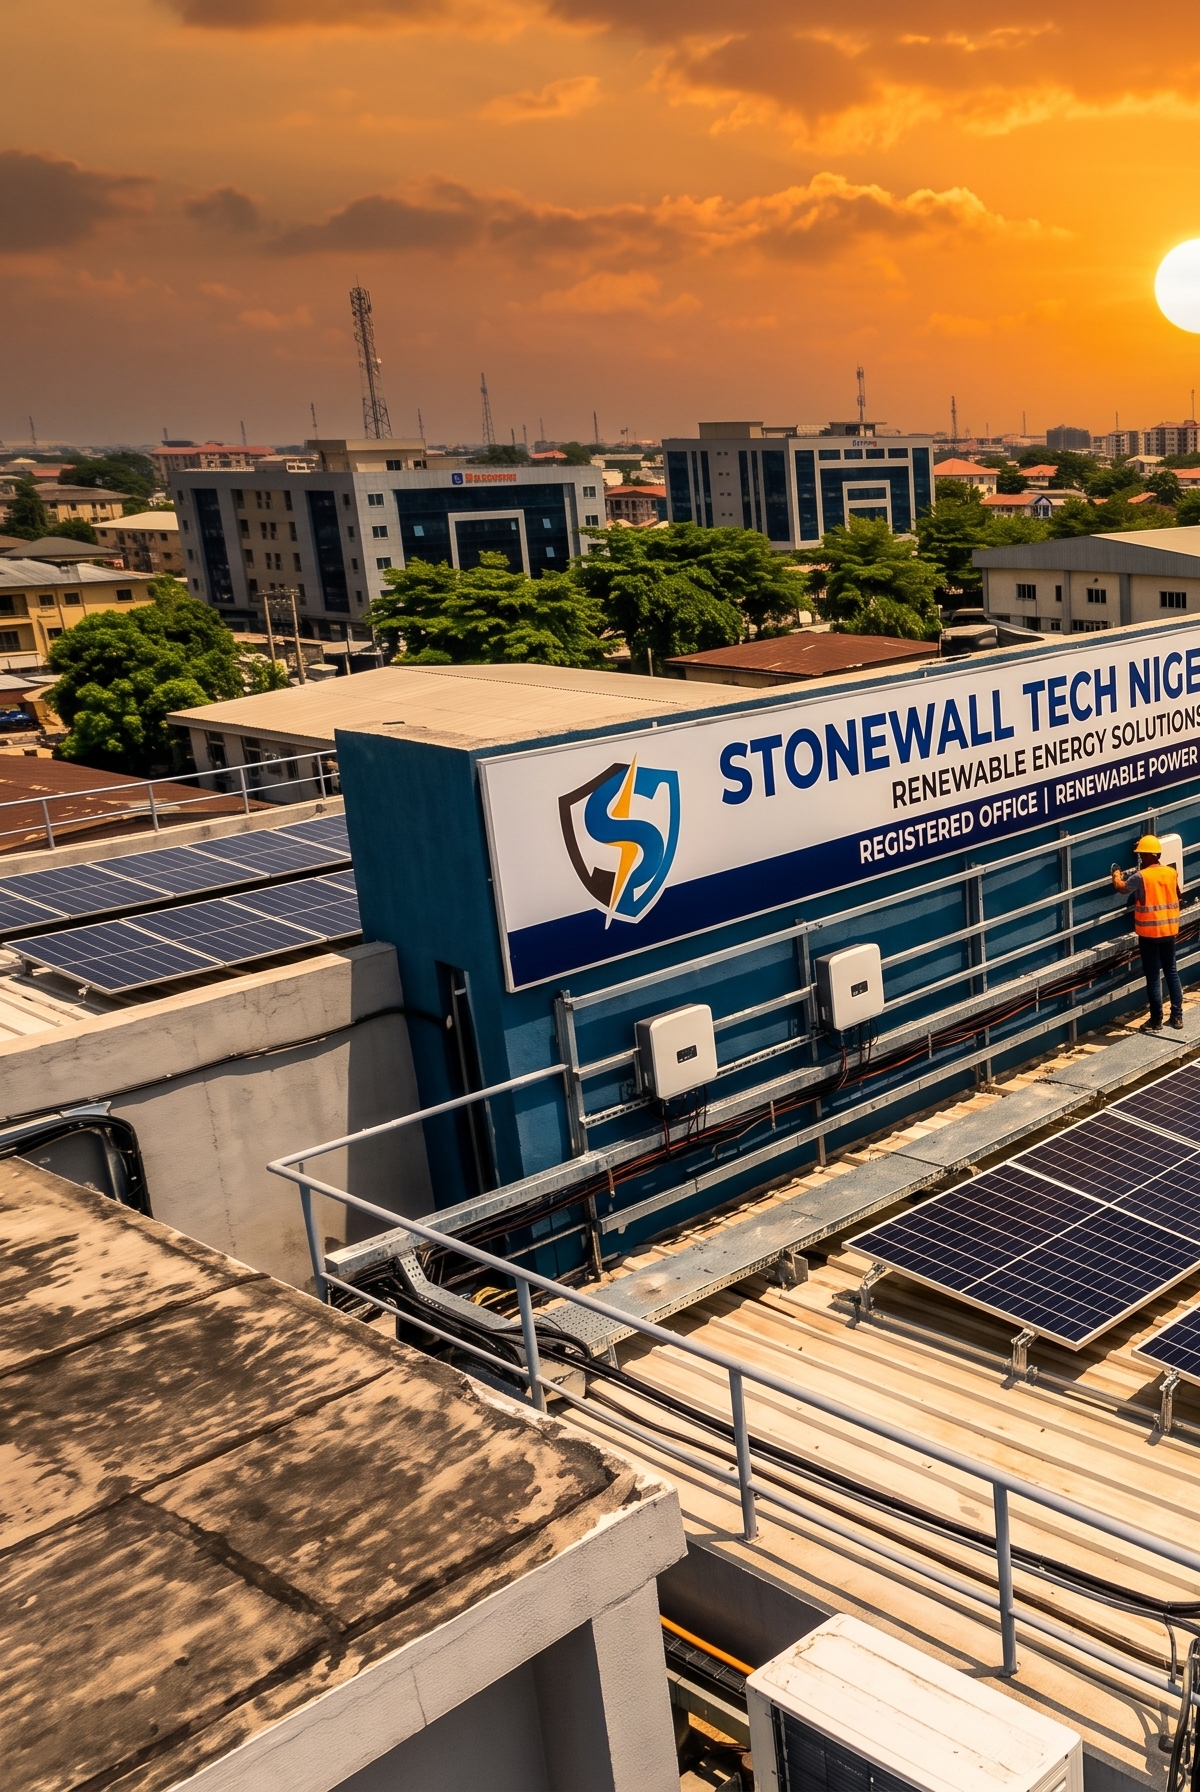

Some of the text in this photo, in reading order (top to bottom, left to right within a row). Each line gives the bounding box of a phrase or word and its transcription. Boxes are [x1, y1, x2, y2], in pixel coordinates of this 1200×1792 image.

[719, 689, 1015, 805] STONEWALL
[1022, 665, 1117, 732] TECH
[892, 749, 1027, 809] RENEWABLE
[1032, 728, 1107, 771] ENERGY
[859, 811, 974, 864] REGISTERED
[979, 791, 1038, 828] OFFICE
[1055, 760, 1145, 806] RENEWABLE
[1149, 745, 1198, 778] POWER
